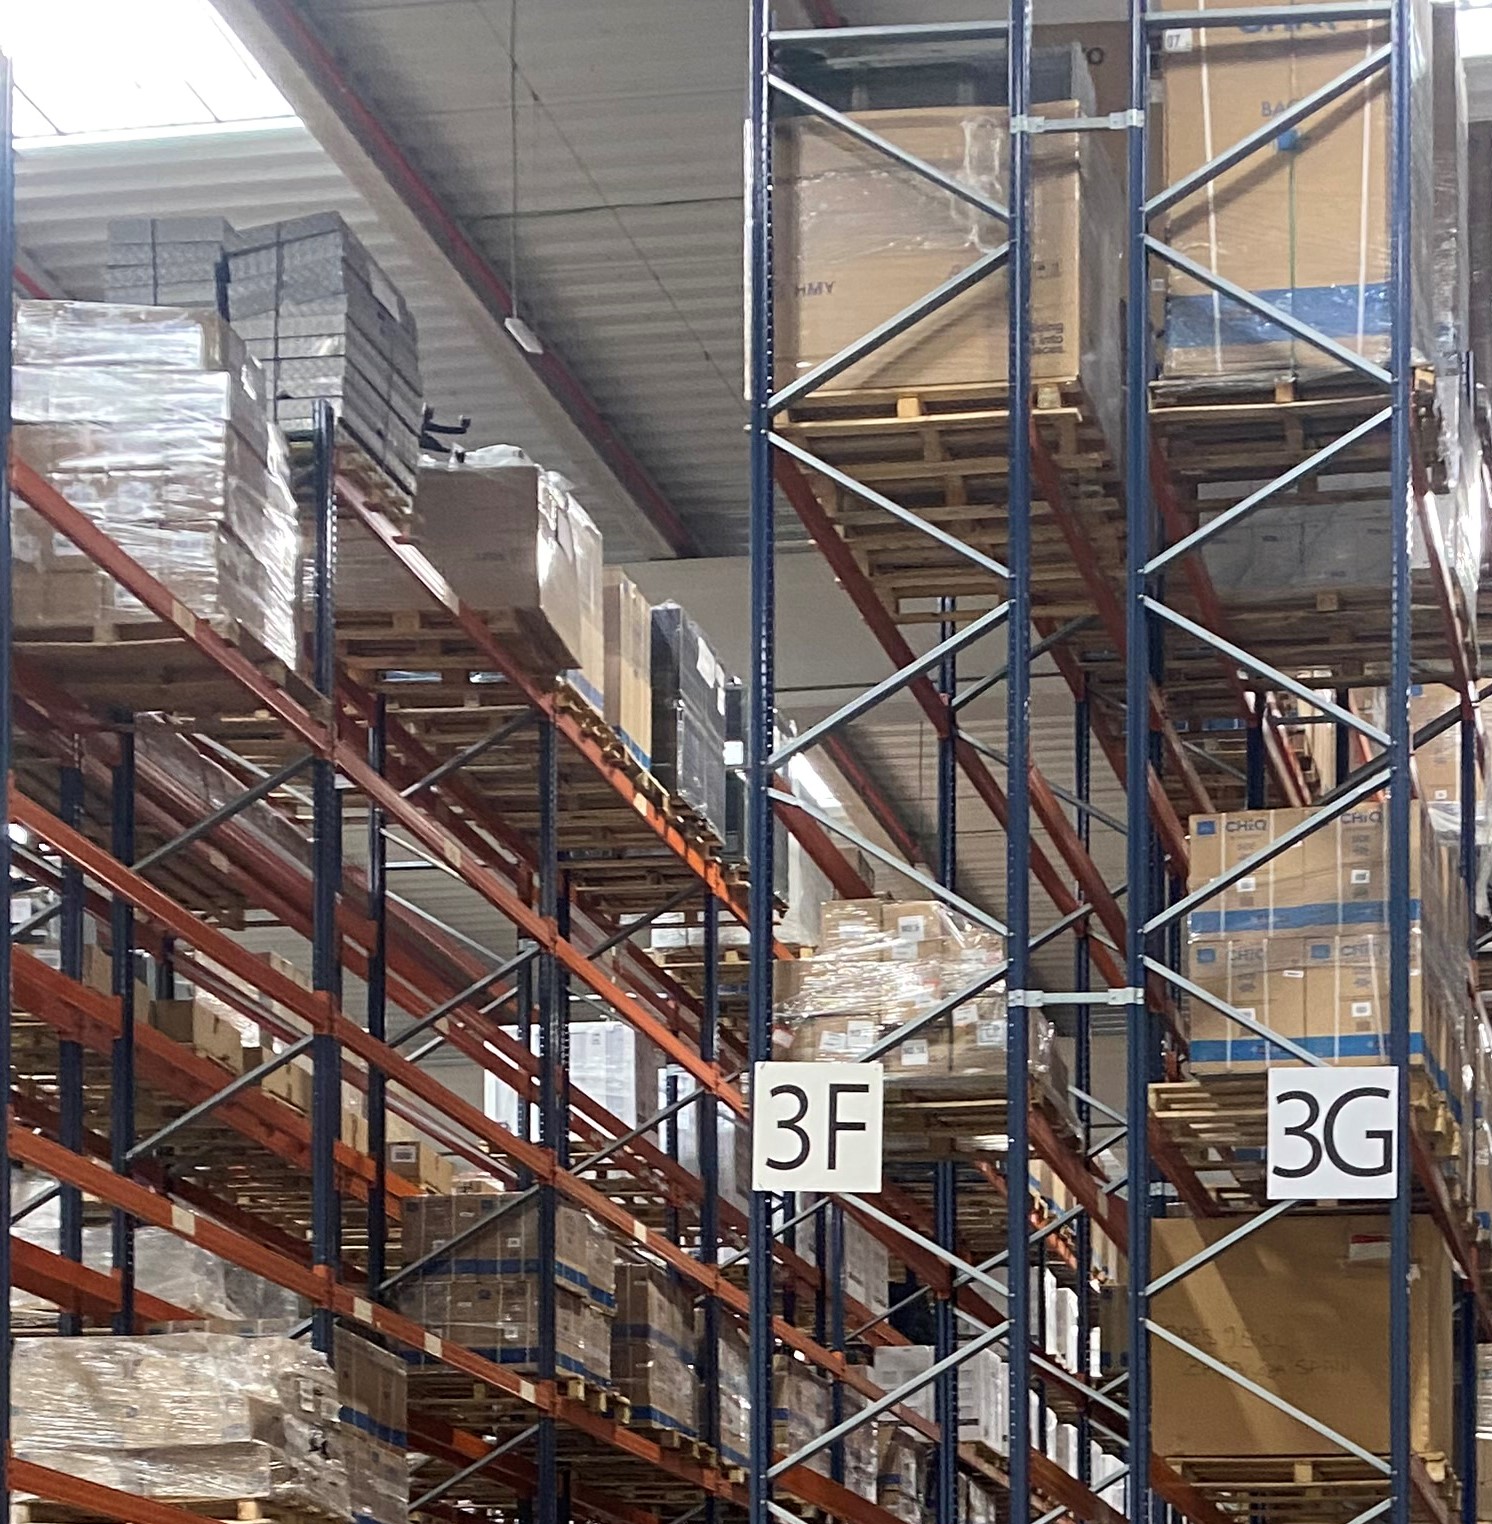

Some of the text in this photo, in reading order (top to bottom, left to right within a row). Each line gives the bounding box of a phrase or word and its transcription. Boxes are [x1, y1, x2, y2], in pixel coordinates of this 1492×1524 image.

[1226, 818, 1268, 833] CHiQ
[1340, 811, 1383, 826] CHiQ
[765, 1083, 870, 1172] 3F
[1272, 1087, 1393, 1179] 3G
